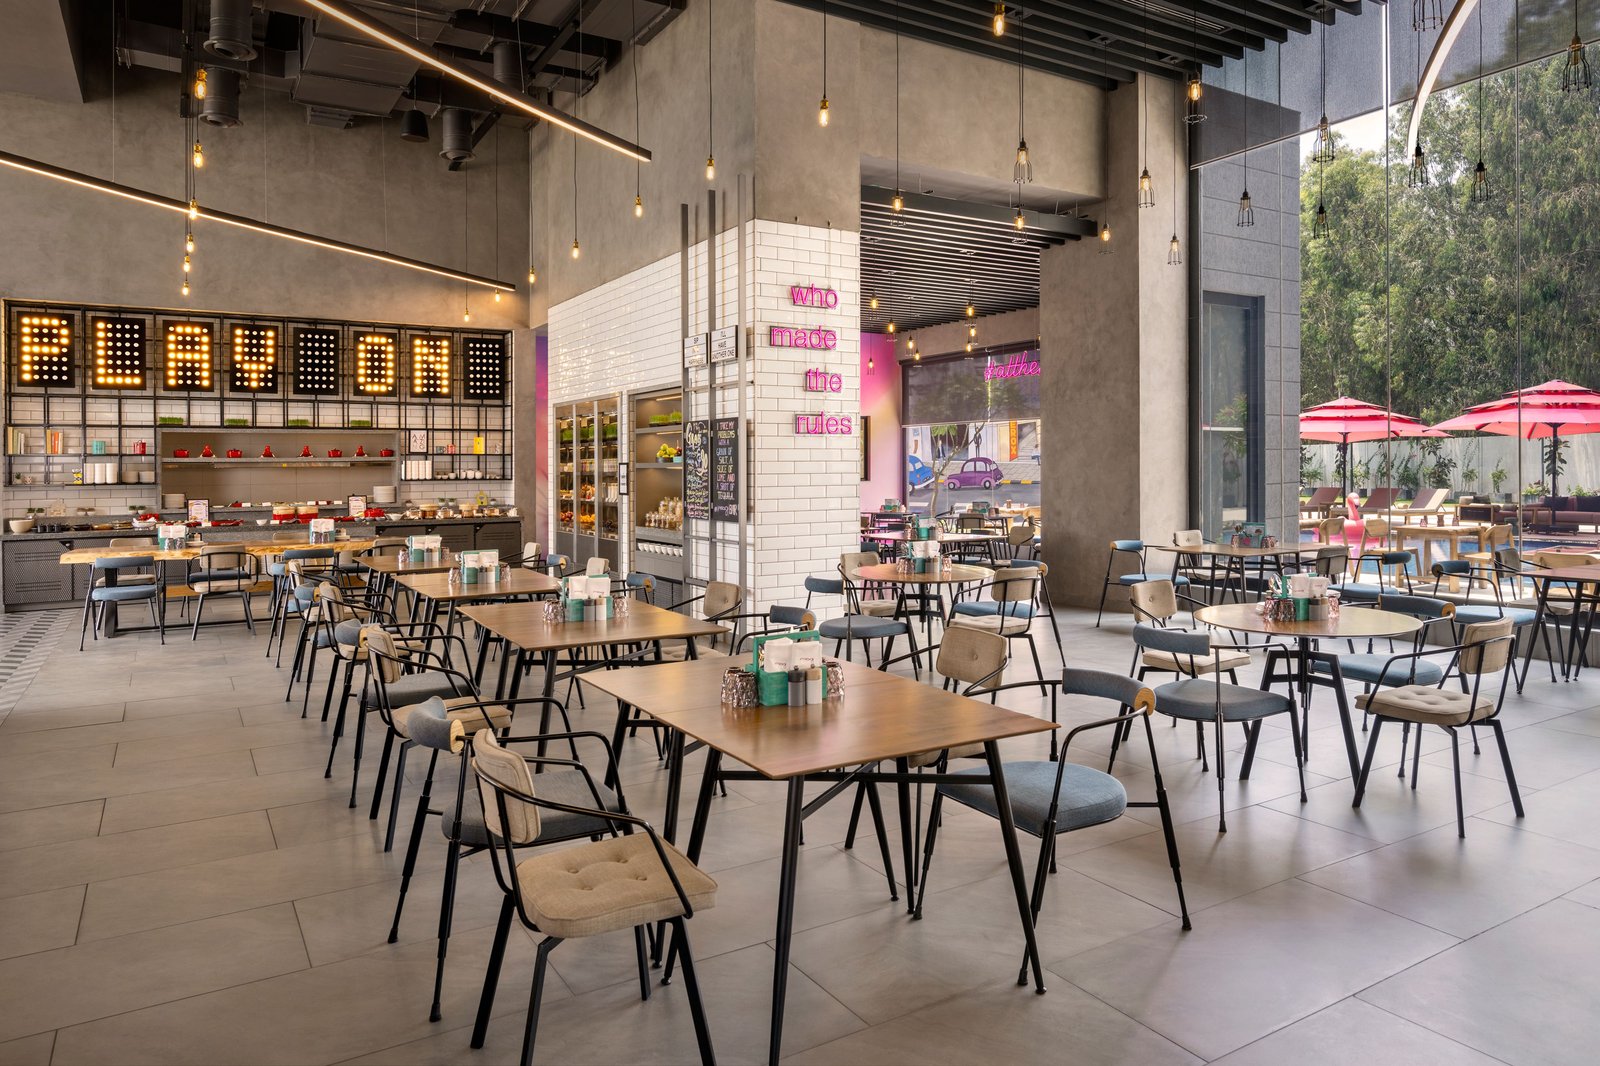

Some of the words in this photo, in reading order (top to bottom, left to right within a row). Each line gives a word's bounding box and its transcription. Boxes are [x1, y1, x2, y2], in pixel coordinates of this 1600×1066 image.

[791, 283, 838, 309] who
[771, 325, 837, 349] made
[21, 316, 276, 389] PLAY
[357, 335, 451, 394] ON
[984, 351, 1040, 382] #atthe
[806, 367, 842, 392] the
[797, 411, 852, 434] rules
[1009, 421, 1017, 455] EROX
